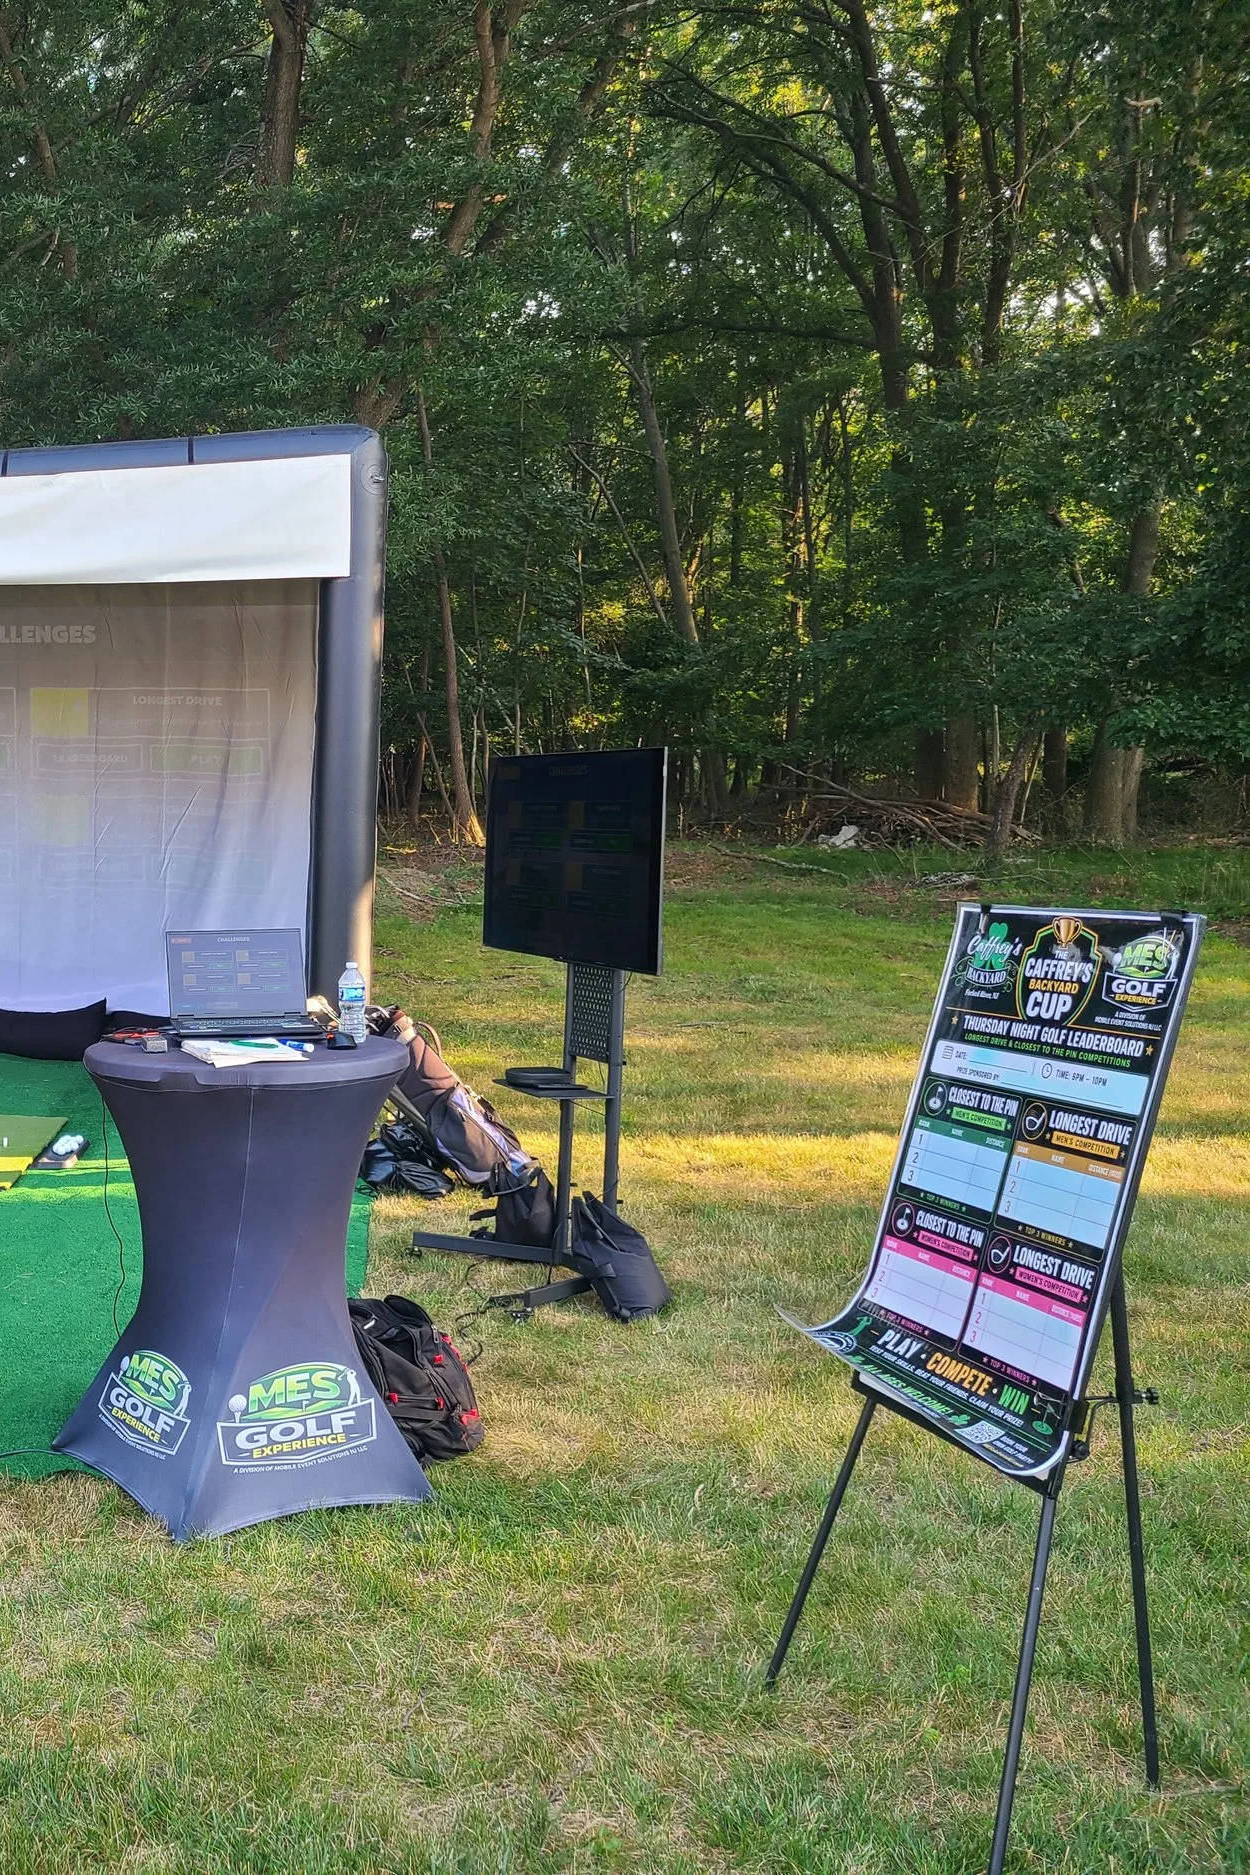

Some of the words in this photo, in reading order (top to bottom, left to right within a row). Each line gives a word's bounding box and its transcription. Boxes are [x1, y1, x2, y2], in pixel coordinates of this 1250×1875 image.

[133, 696, 183, 706] LONGEST
[186, 696, 222, 706] DRIVE
[967, 935, 1022, 962] Caffrey's
[1055, 951, 1068, 959] THE
[1120, 943, 1168, 970] MES
[966, 968, 1006, 985] BACKYARD
[1025, 958, 1094, 983] CAFFREY'S
[1029, 979, 1079, 994] BACKYARD
[1111, 979, 1166, 997] GOLF
[1026, 990, 1072, 1020] CUP
[1115, 994, 1157, 1005] EXPERIENCE
[963, 1014, 1010, 1035] THURSDAY
[1010, 1021, 1040, 1040] NIGHT
[1040, 1026, 1066, 1045] GOLF
[1066, 1030, 1144, 1057] LEADERBOARD
[965, 1033, 990, 1043] LONGEST
[990, 1037, 1007, 1046] DRIVE
[1008, 1040, 1013, 1048] &
[1013, 1041, 1040, 1052] CLOSEST
[1042, 1045, 1050, 1054] TO
[1052, 1047, 1064, 1056] THE
[1065, 1049, 1077, 1059] PIN
[1078, 1052, 1131, 1068] COMPETITIONS
[968, 1068, 993, 1081] SPONSORED
[1055, 1069, 1071, 1080] TIME:
[1071, 1072, 1085, 1082] 6PM
[1092, 1076, 1108, 1087] 10PM
[948, 1086, 981, 1109] CLOSEST
[980, 1094, 991, 1111] TO
[990, 1096, 1006, 1115] THE
[1004, 1098, 1019, 1117] PIN
[955, 1110, 970, 1121] MEN'S
[970, 1113, 1004, 1127] COMPETITION
[1049, 1110, 1098, 1137] LONGEST
[1097, 1120, 1133, 1145] DRIVE
[918, 1133, 924, 1145] 1
[1055, 1134, 1074, 1145] MEN'S
[1075, 1138, 1115, 1155] COMPETITION
[912, 1152, 919, 1164] 2
[1015, 1160, 1021, 1173] 1
[908, 1170, 914, 1182] 3
[1009, 1180, 1017, 1194] 2
[1004, 1200, 1012, 1213] 3
[916, 1210, 948, 1234] CLOSEST
[947, 1220, 957, 1238] TO
[955, 1222, 971, 1245] THE
[968, 1228, 985, 1248] PIN
[1024, 1226, 1035, 1235] TOP
[1040, 1230, 1066, 1246] WINNERS
[940, 1239, 971, 1258] COMPETITION
[886, 1254, 890, 1264] 1
[1013, 1245, 1061, 1276] LONGEST
[1060, 1261, 1095, 1289] DRIVE
[878, 1271, 885, 1282] 2
[1018, 1271, 1043, 1285] WOMEN'S
[1043, 1279, 1080, 1299] COMPETITION
[871, 1288, 878, 1298] 3
[982, 1293, 987, 1305] 1
[975, 1311, 982, 1324] 2
[969, 1331, 976, 1343] 3
[125, 1353, 180, 1401] MES
[877, 1329, 922, 1359] PLAY
[926, 1352, 993, 1396] COMPETE
[998, 1384, 1030, 1415] WIN
[990, 1358, 1001, 1368] TOP
[1006, 1366, 1030, 1383] WINNERS
[248, 1371, 340, 1413] MES
[878, 1374, 906, 1388] AGES
[902, 1385, 953, 1414] WELCOME!
[915, 1368, 930, 1380] BEAT
[929, 1375, 946, 1388] YOUR
[969, 1395, 988, 1410] CLAIM
[987, 1404, 1004, 1419] YOUR
[1003, 1411, 1024, 1427] PRIZE!
[110, 1387, 175, 1434] GOLF
[111, 1407, 161, 1443] EXPERIENCE
[235, 1411, 356, 1450] GOLF
[252, 1433, 347, 1459] EXPERIENCE
[239, 1466, 264, 1474] DIVISION
[274, 1463, 297, 1471] MOBILE
[297, 1460, 317, 1468] EVENT
[317, 1452, 350, 1464] SOLUTIONS
